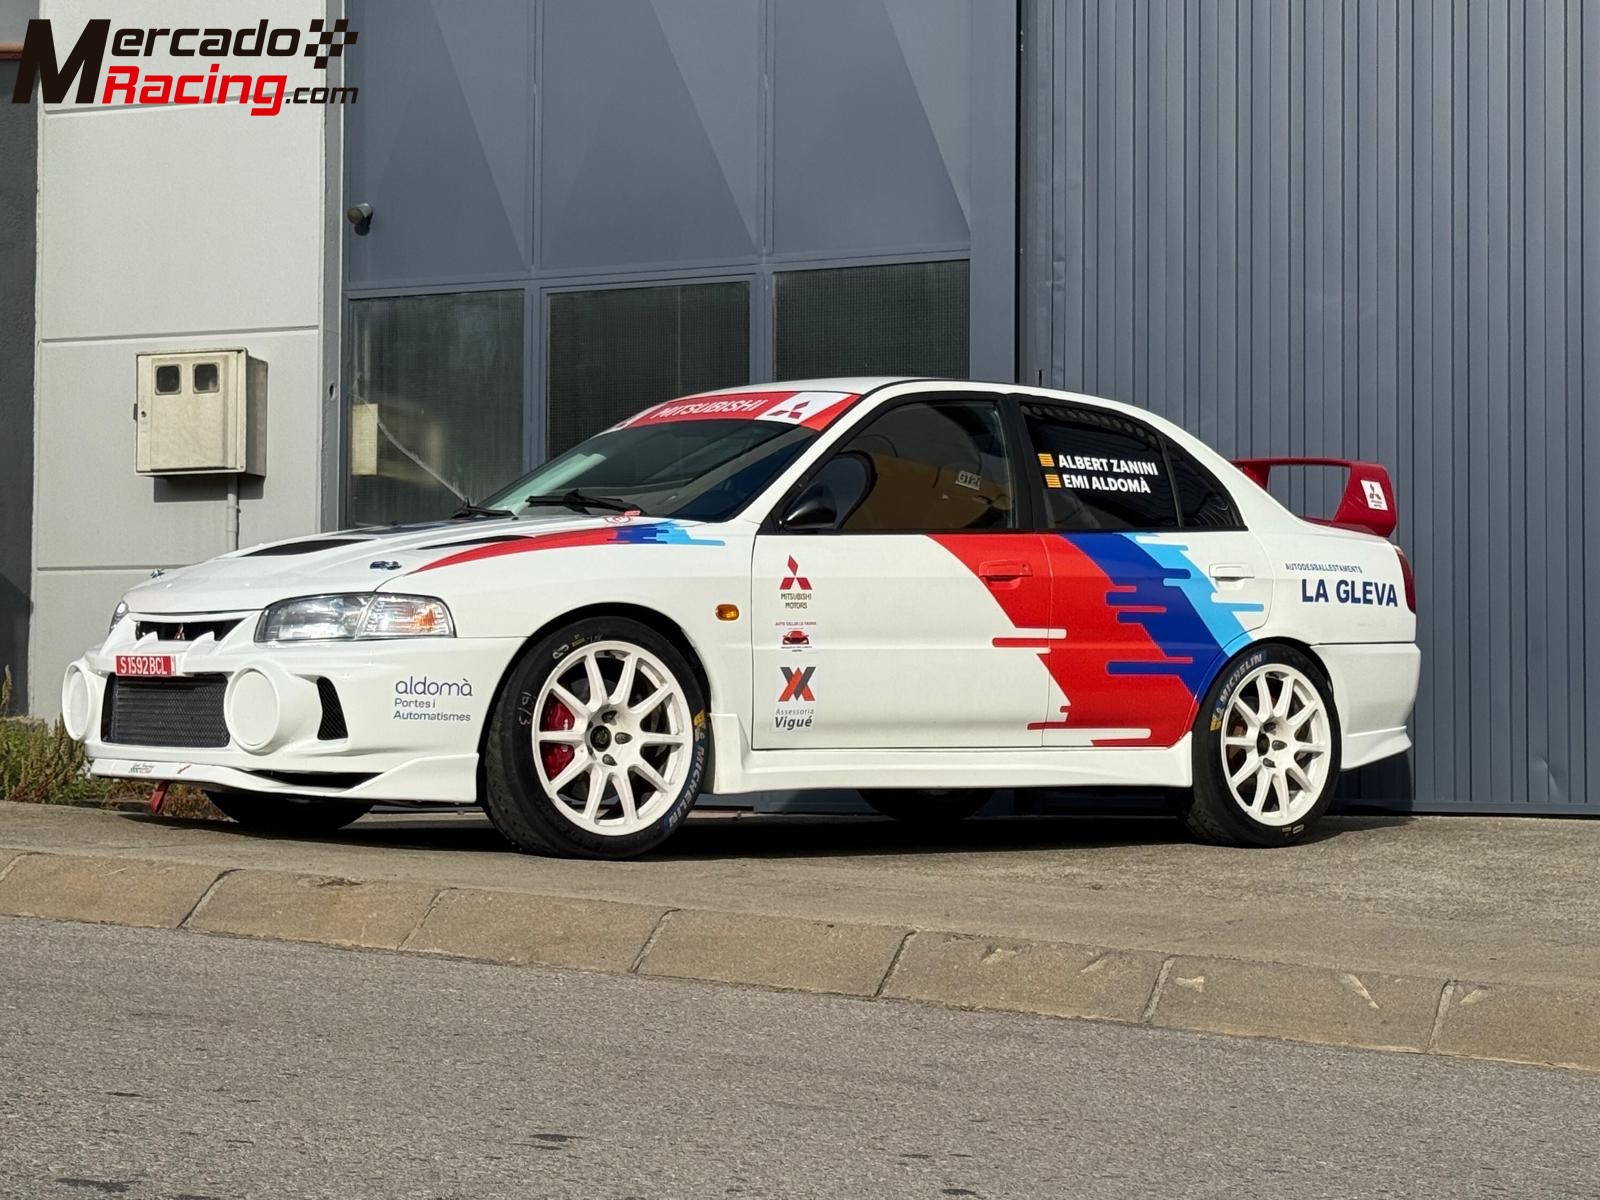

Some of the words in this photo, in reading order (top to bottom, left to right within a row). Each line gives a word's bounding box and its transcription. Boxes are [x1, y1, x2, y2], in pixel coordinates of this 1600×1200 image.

[650, 399, 768, 419] MITSUBISHI
[1059, 454, 1109, 471] ALBERT
[1110, 459, 1159, 475] ZANINI
[1062, 473, 1090, 489] EMI
[1091, 476, 1151, 494] ALDOMÀ
[780, 592, 812, 600] MITSUBISHI
[1301, 578, 1329, 603] LA
[1335, 579, 1398, 607] GLEVA
[785, 601, 808, 609] MOTORS
[395, 675, 473, 697] aldomà
[1220, 653, 1262, 704] MICHELIN
[394, 697, 431, 709] Portes
[775, 708, 814, 716] Assessoria
[393, 710, 471, 721] Automatismes
[775, 715, 813, 731] Vigué
[668, 746, 704, 828] MICHELIN
